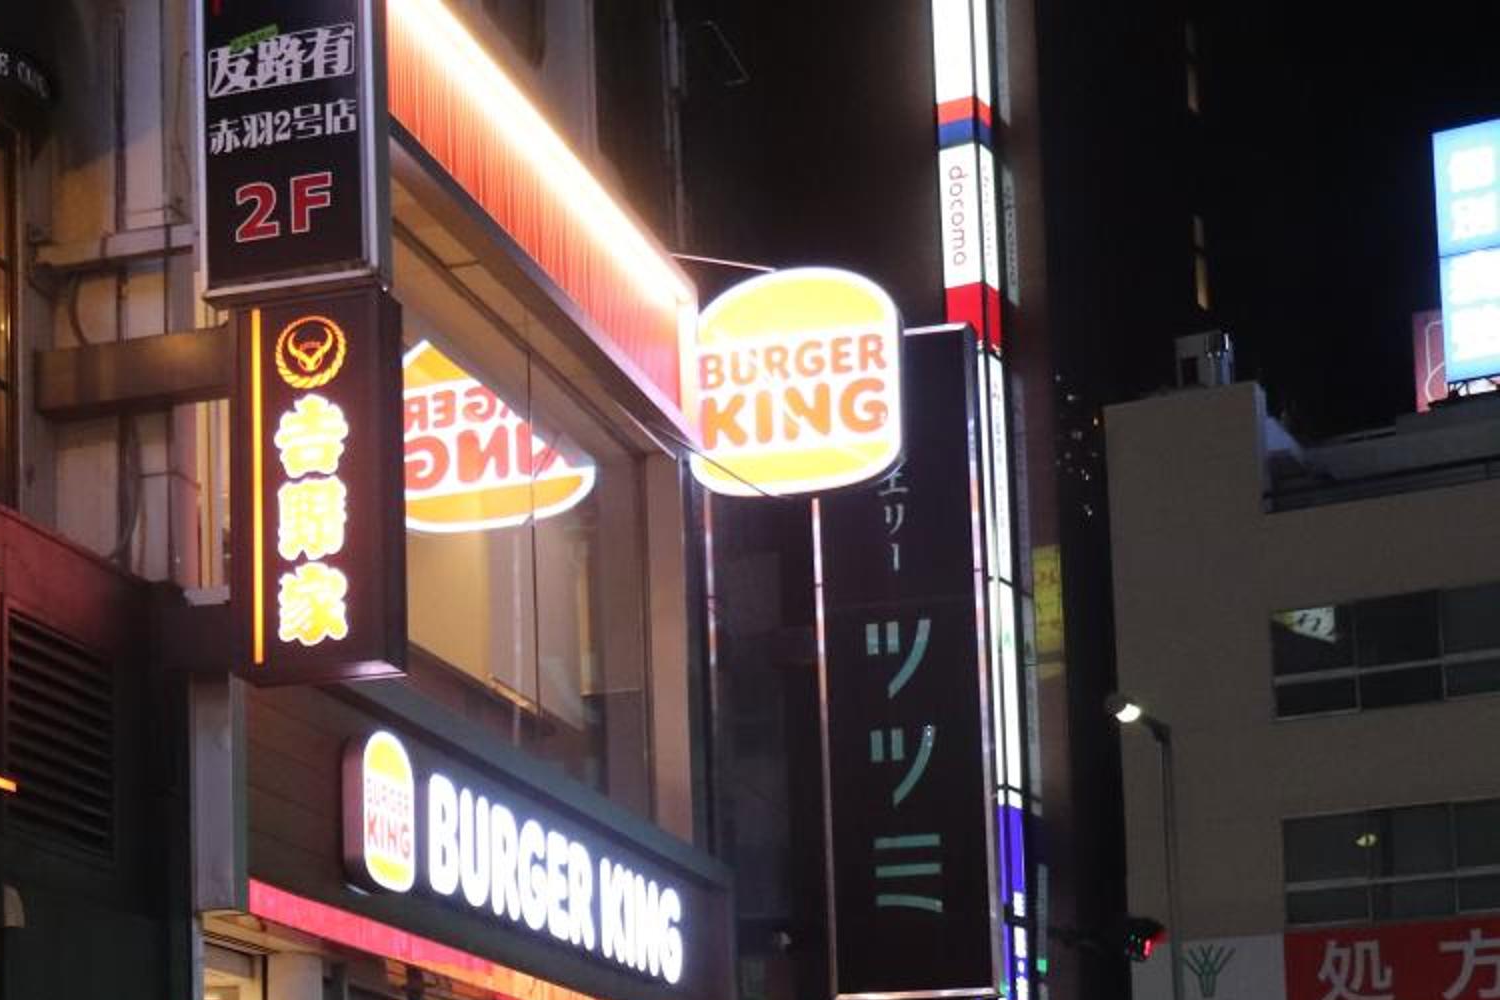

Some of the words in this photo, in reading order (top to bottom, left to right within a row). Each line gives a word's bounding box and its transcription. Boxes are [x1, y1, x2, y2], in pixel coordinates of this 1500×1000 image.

[210, 28, 353, 96] 友路有
[209, 99, 356, 154] 赤羽2号店
[235, 172, 332, 242] 2F
[949, 165, 970, 266] docomo
[699, 333, 887, 390] BURGER
[701, 377, 889, 450] KING
[878, 466, 909, 571] エリー
[865, 618, 943, 912] ツツミ
[367, 808, 411, 860] KING
[428, 773, 596, 951] BURGER
[599, 857, 684, 985] KING
